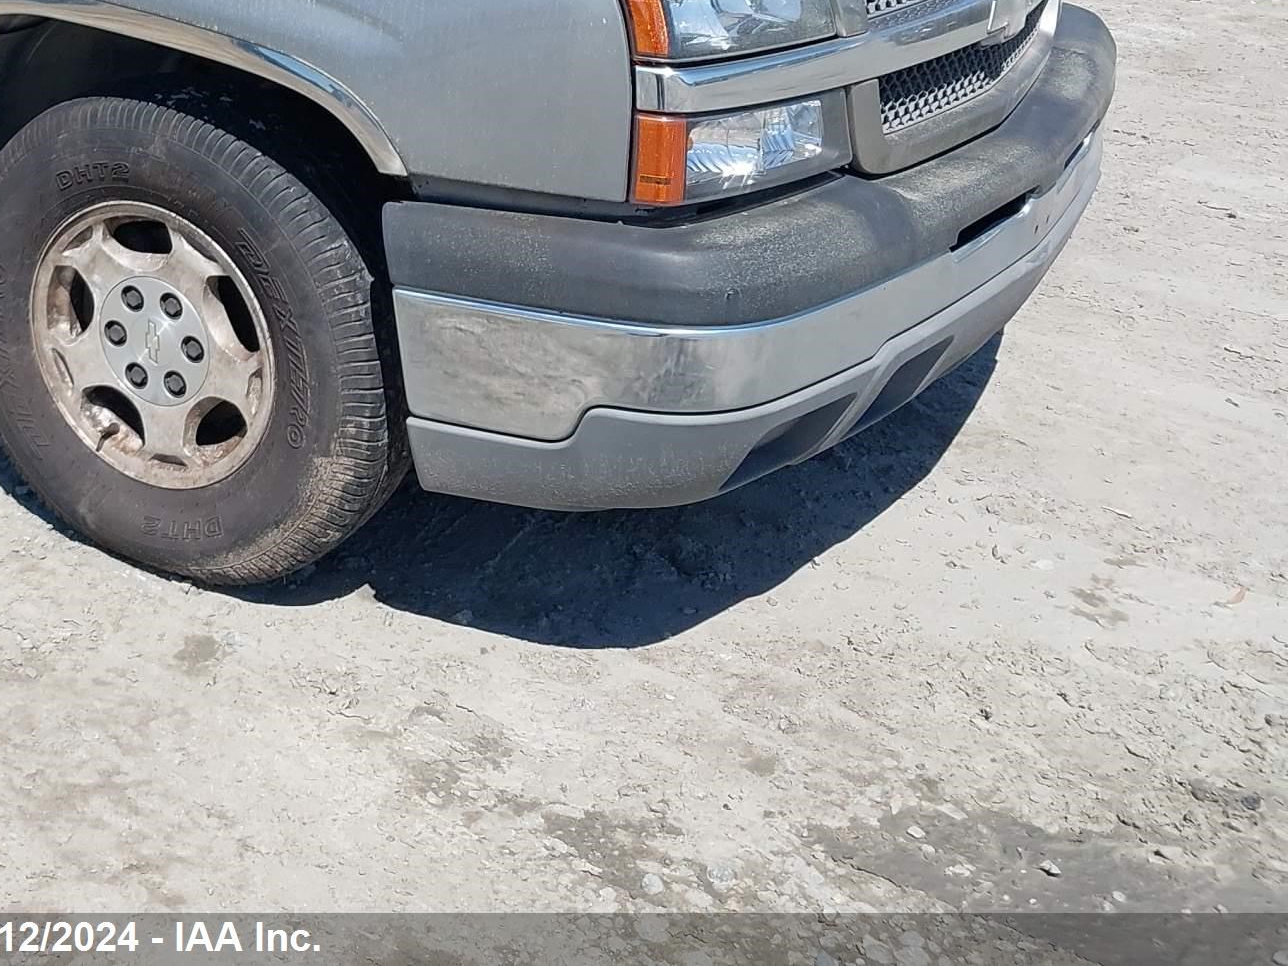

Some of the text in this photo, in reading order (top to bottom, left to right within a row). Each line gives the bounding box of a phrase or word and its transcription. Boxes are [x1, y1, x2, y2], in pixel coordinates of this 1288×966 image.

[56, 161, 129, 191] DHT2
[236, 228, 311, 449] DEXTERO
[140, 514, 225, 543] DHT2
